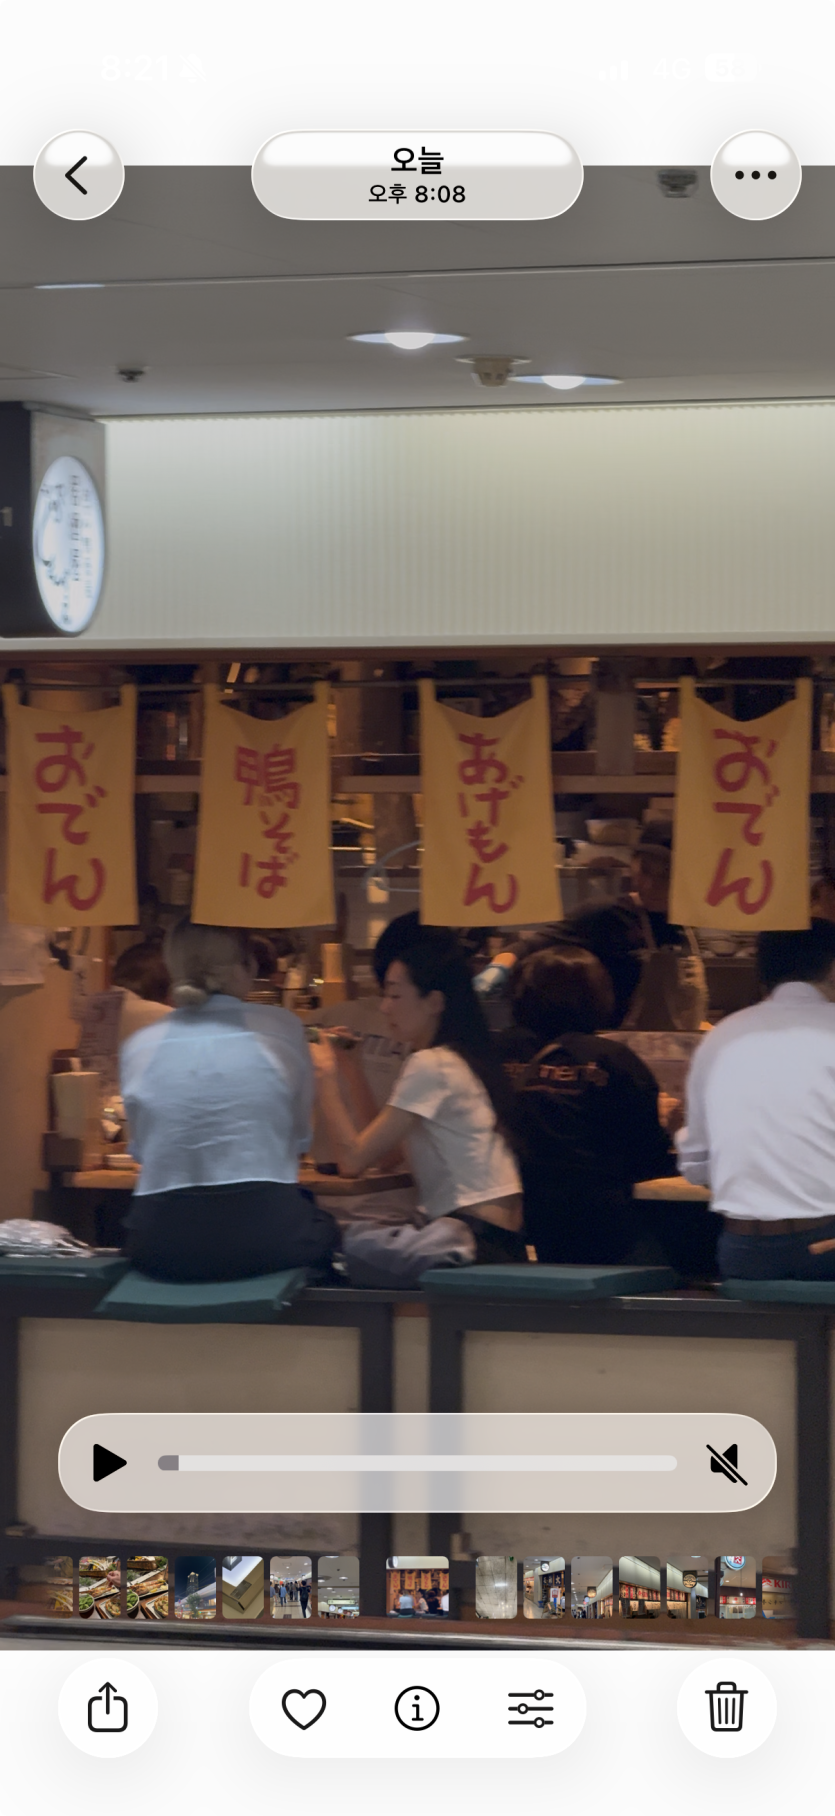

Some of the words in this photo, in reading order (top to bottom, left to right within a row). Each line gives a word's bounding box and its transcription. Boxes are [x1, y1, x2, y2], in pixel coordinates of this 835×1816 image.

[34, 725, 107, 911] おでん
[235, 744, 300, 899] 鴨そば
[458, 733, 524, 914] あげもん
[704, 728, 779, 915] おでん
